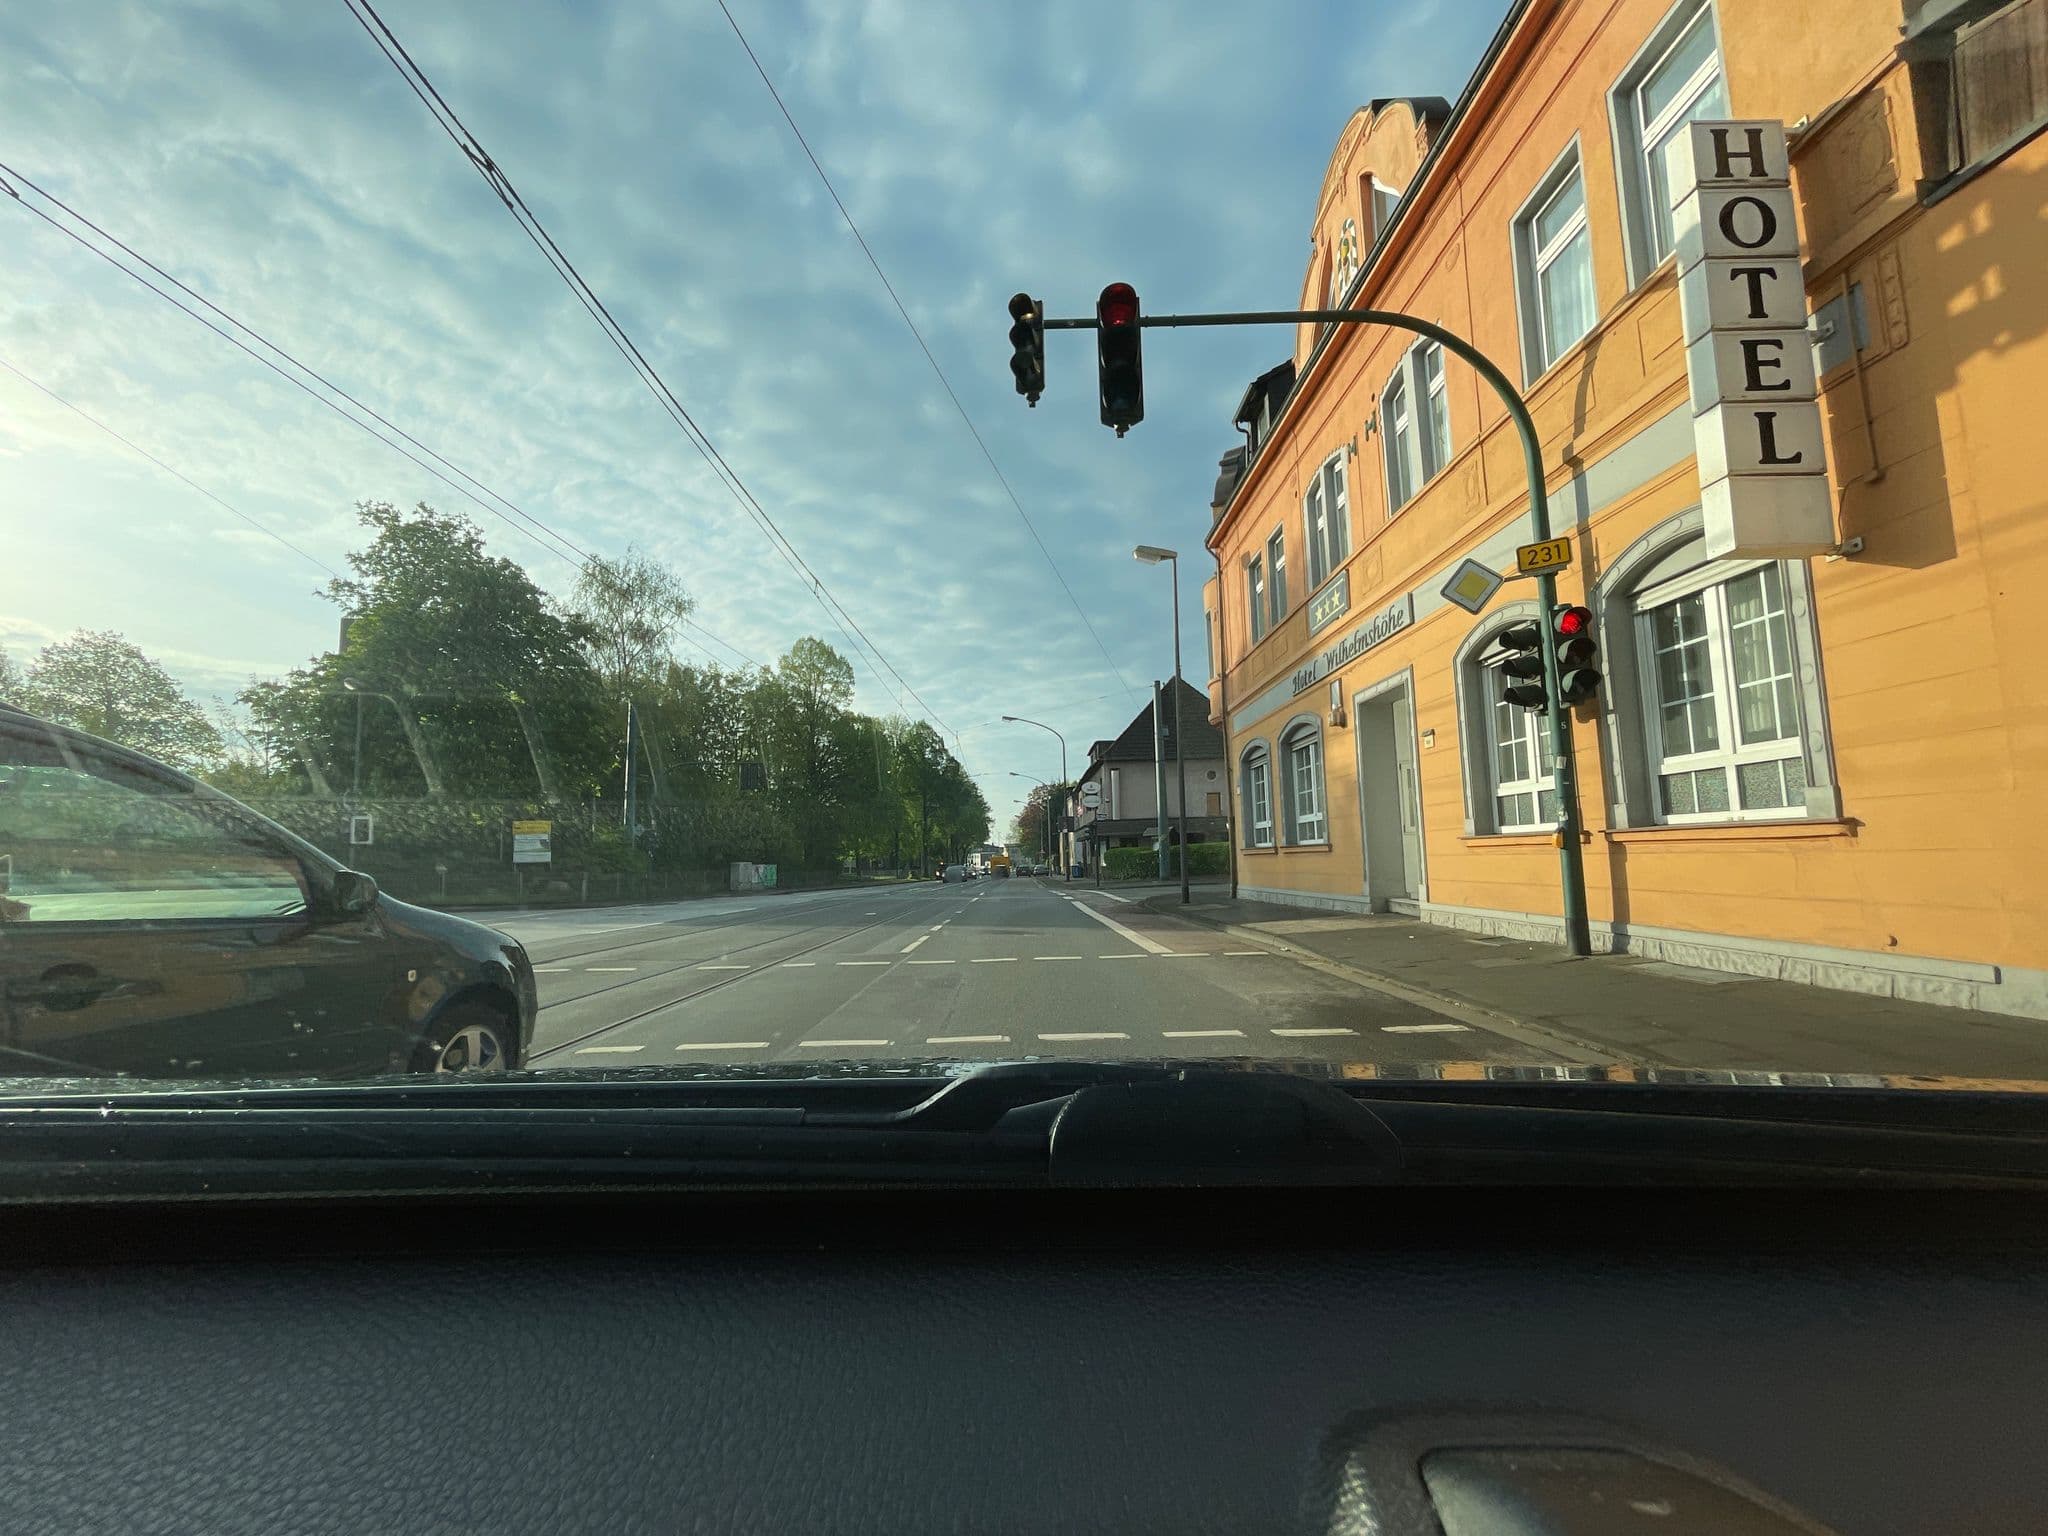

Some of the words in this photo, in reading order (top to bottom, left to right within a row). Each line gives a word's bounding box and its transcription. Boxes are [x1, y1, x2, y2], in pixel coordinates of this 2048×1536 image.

[1710, 128, 1802, 464] HOTEL
[1527, 543, 1562, 566] 231
[1292, 659, 1319, 694] Hotel
[1322, 604, 1405, 672] Wilhelmshöhe
